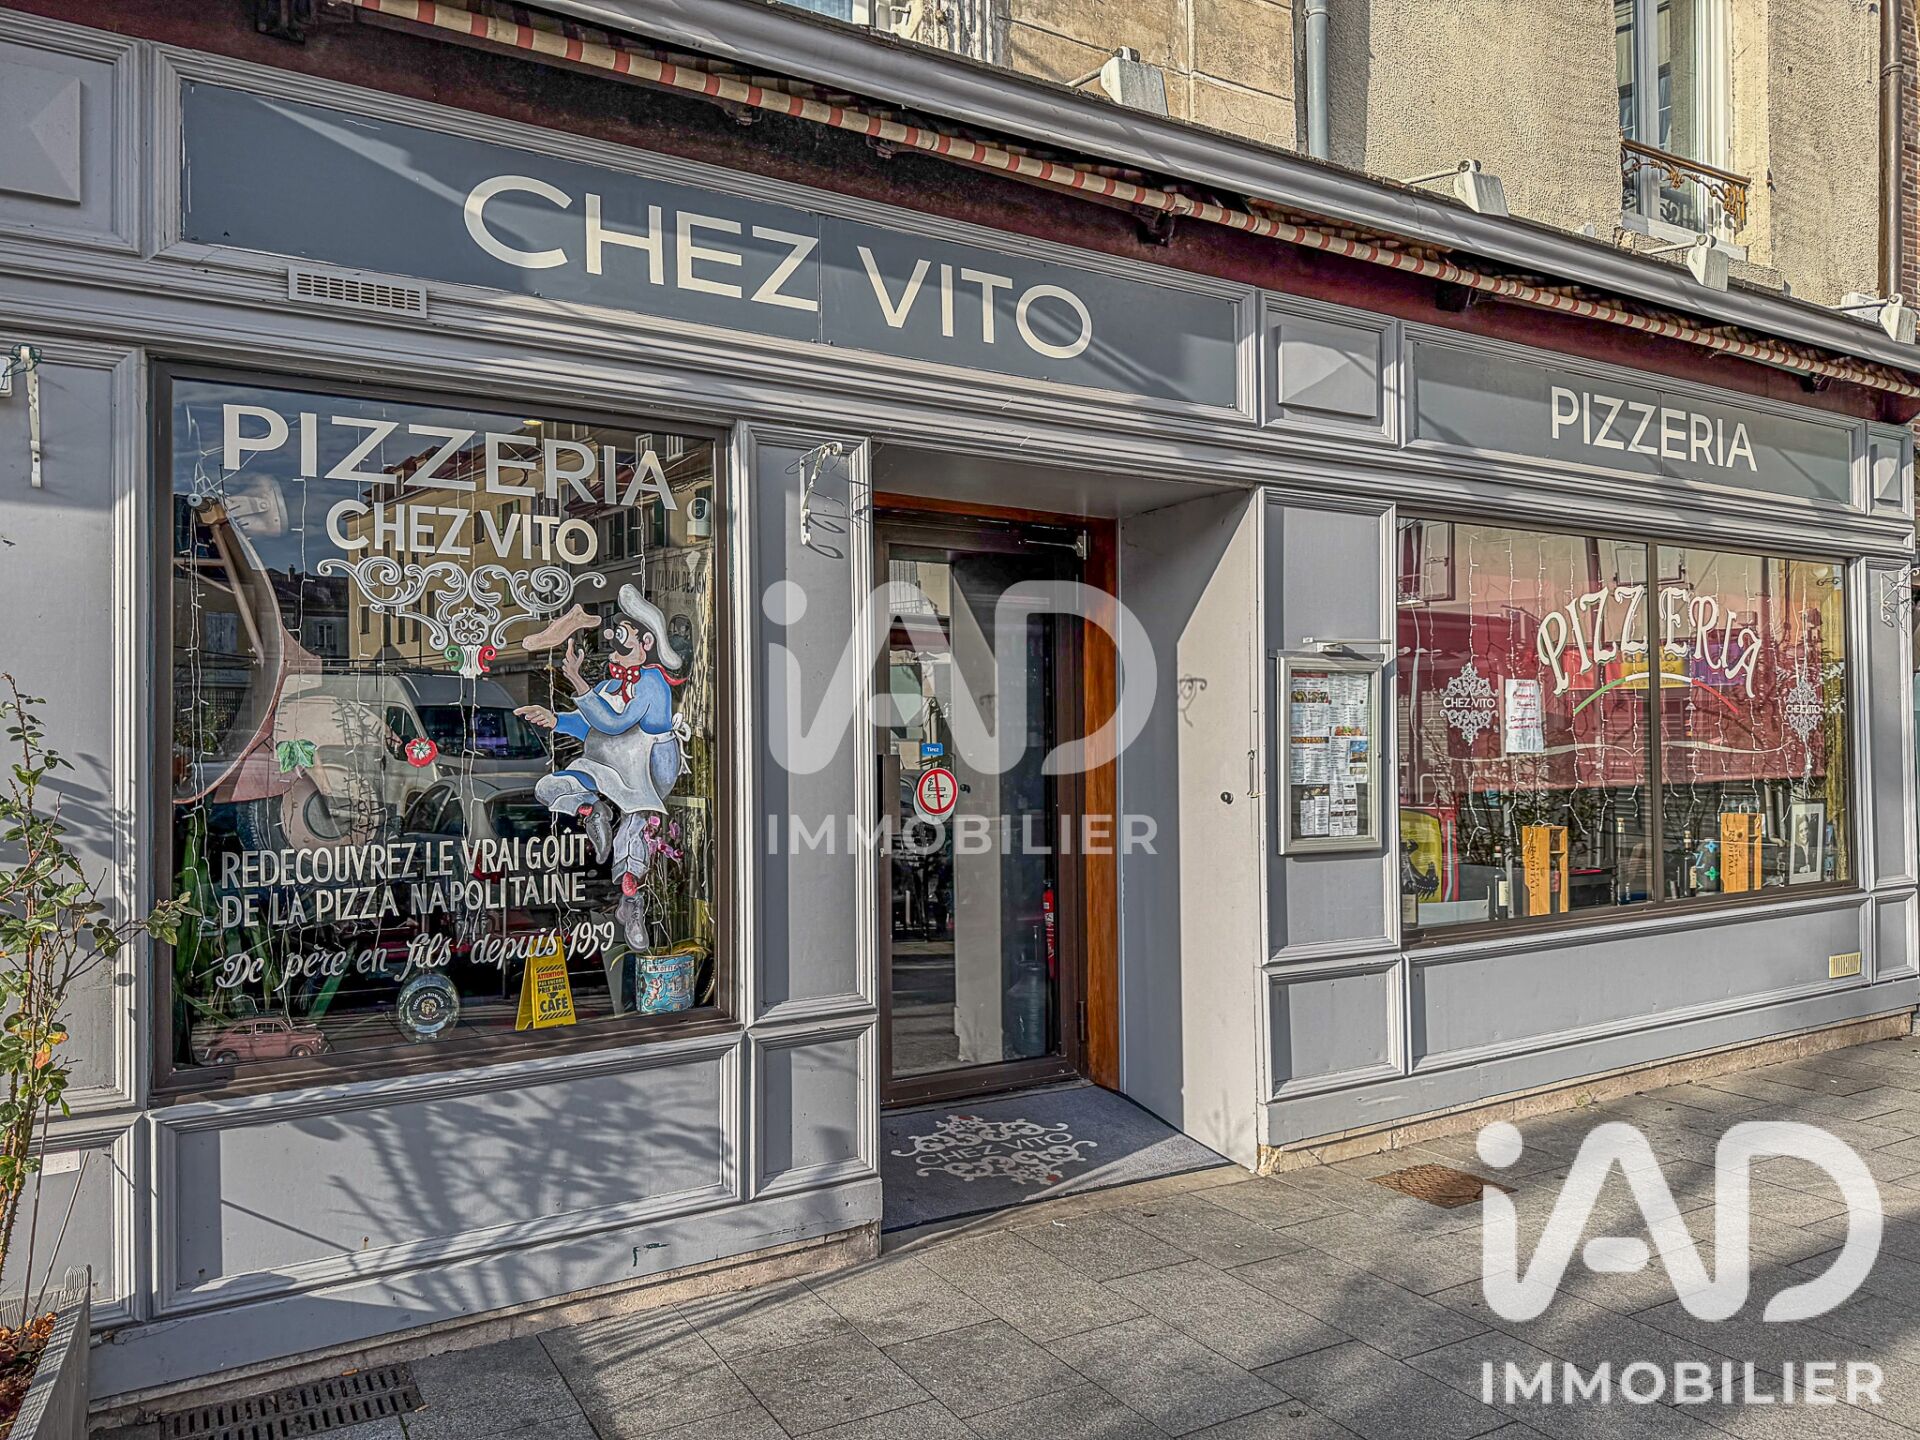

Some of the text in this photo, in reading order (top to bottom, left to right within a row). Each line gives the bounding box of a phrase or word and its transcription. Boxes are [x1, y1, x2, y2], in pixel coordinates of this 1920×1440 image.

[464, 175, 1092, 359] CHEZ VITO
[222, 403, 678, 511] PIZZERIA
[1550, 385, 1758, 473] PIZZERIA
[326, 499, 599, 565] CHEZ VITO
[1536, 584, 1762, 698] PIZZERIA
[1442, 697, 1496, 708] CHEZ VITO
[221, 827, 588, 890] REDECOUVREZ LE VRAI GOÛT
[221, 870, 587, 929] DE LA PIZZA NAPOLITAINE
[216, 920, 615, 992] De père en fils depuis 1959
[538, 986, 551, 994] PRIS
[540, 994, 569, 1014] CAFÉ
[916, 1132, 1074, 1166] CHEZ VITO
